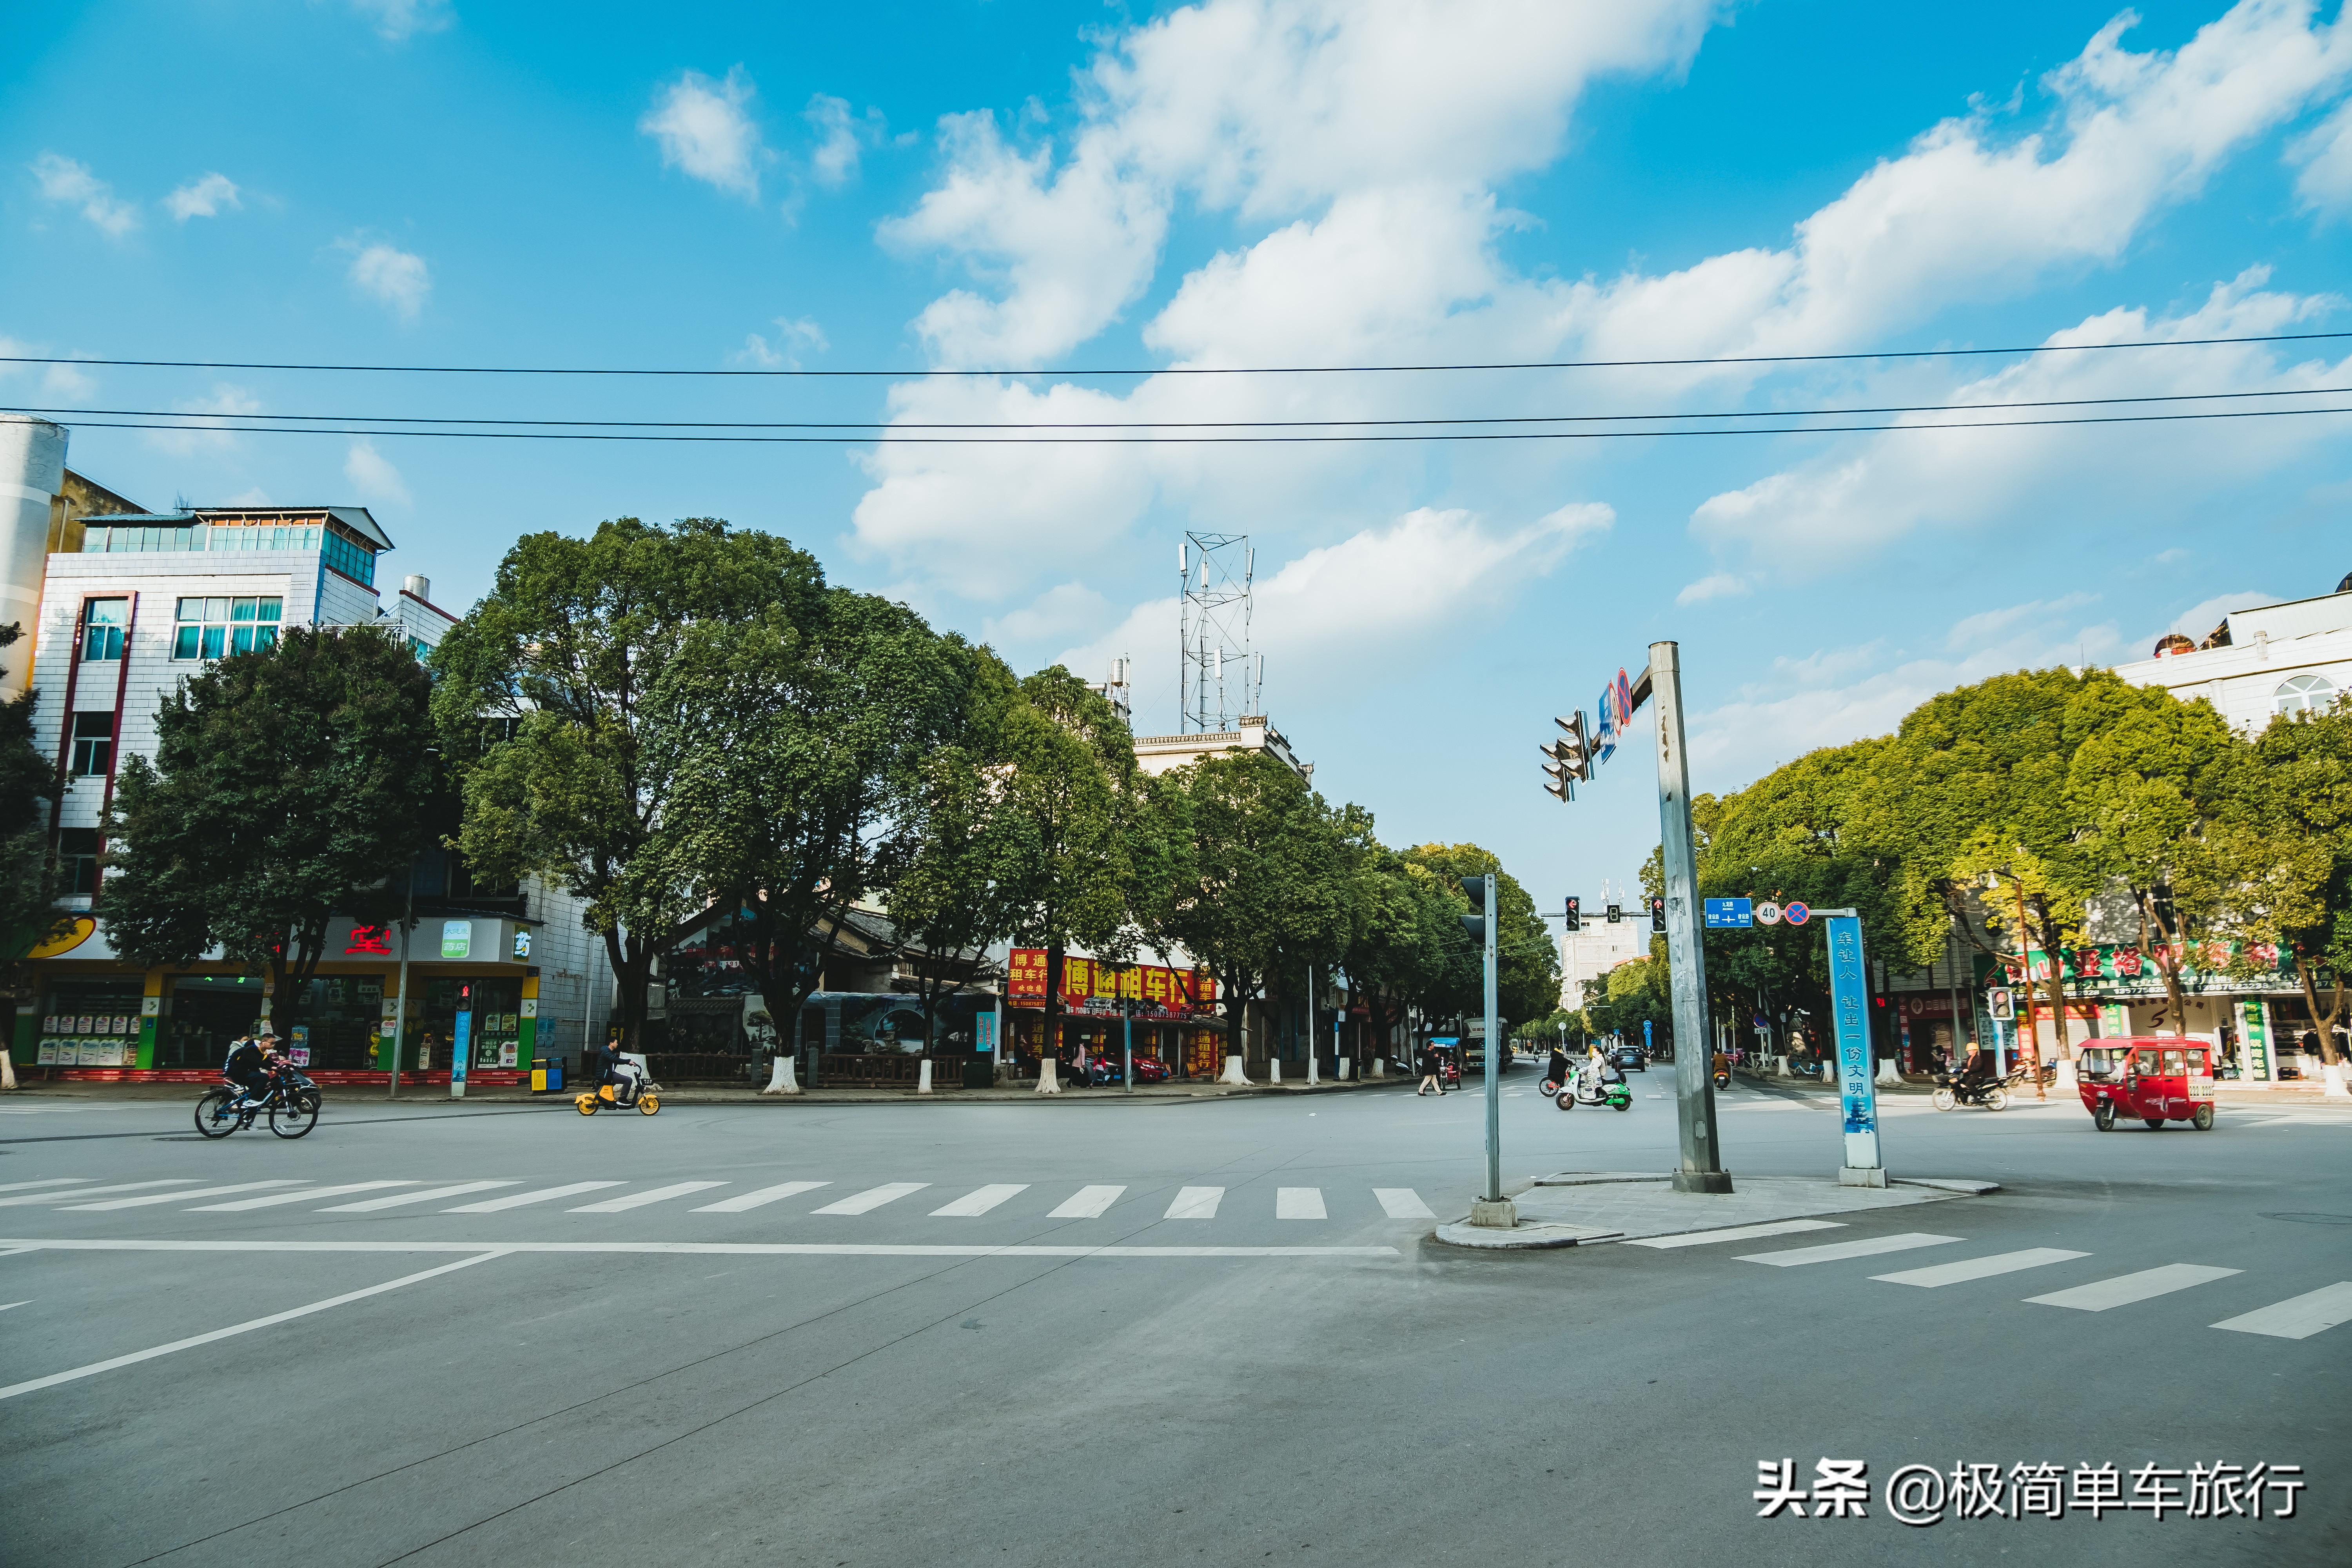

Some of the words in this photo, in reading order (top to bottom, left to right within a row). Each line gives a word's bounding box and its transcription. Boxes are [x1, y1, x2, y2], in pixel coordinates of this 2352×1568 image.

[1762, 907, 1775, 918] 40
[443, 942, 467, 951] 药店
[514, 931, 532, 957] 药
[1014, 954, 1046, 966] 博通
[1837, 932, 1857, 980] 车让人
[1009, 969, 1047, 981] 租车行
[1065, 958, 1188, 1003] 博通租车行
[1018, 984, 1043, 993] 欢迎您
[1198, 1029, 1211, 1067] 博通租车行
[1841, 996, 1866, 1095] 让出一份文明
